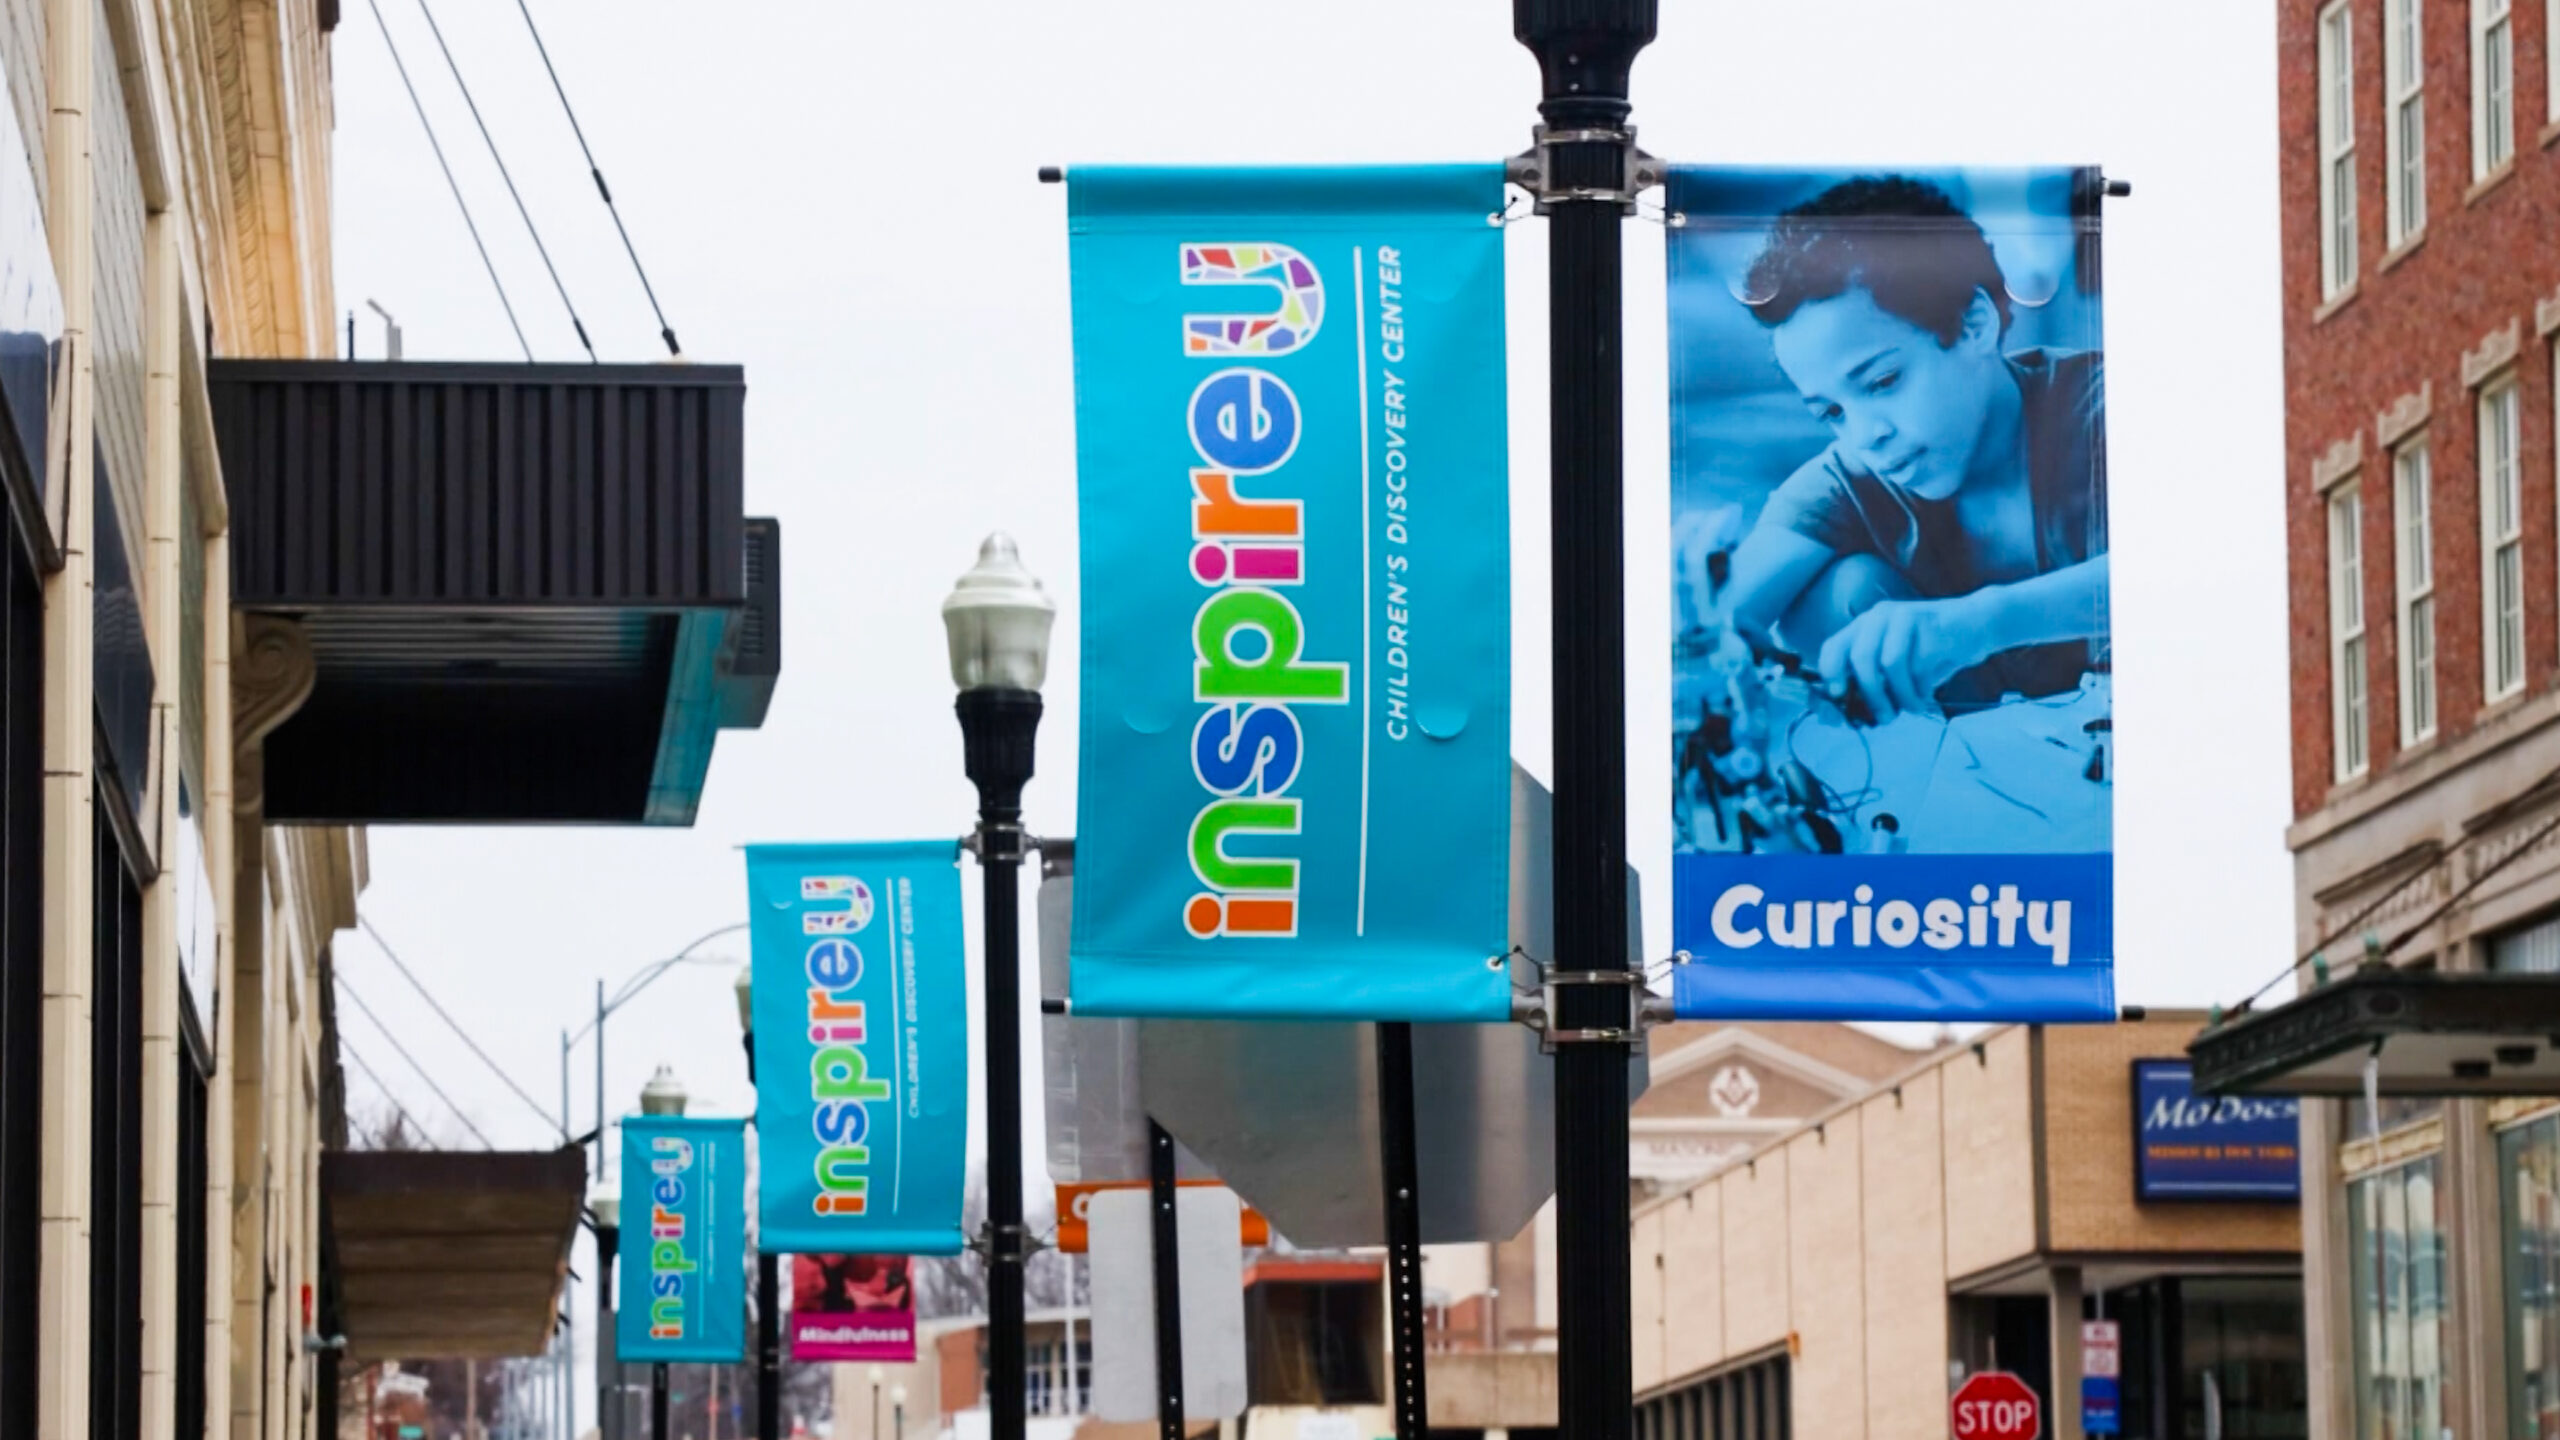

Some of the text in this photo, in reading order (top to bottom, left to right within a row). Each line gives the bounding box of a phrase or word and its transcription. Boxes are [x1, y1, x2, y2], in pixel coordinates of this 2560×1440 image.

[1378, 245, 1405, 362] CENTER
[1382, 369, 1408, 545] DISCOVERY
[1180, 242, 1350, 940] inspireU
[898, 876, 913, 934] CENTER
[1711, 883, 2072, 966] Curiosity
[902, 936, 918, 1023] DISCOVERY
[800, 875, 890, 1217] inspireU
[650, 1137, 698, 1339] inspireU
[799, 1325, 909, 1344] Mindfulness
[1957, 1400, 2032, 1434] STOP
